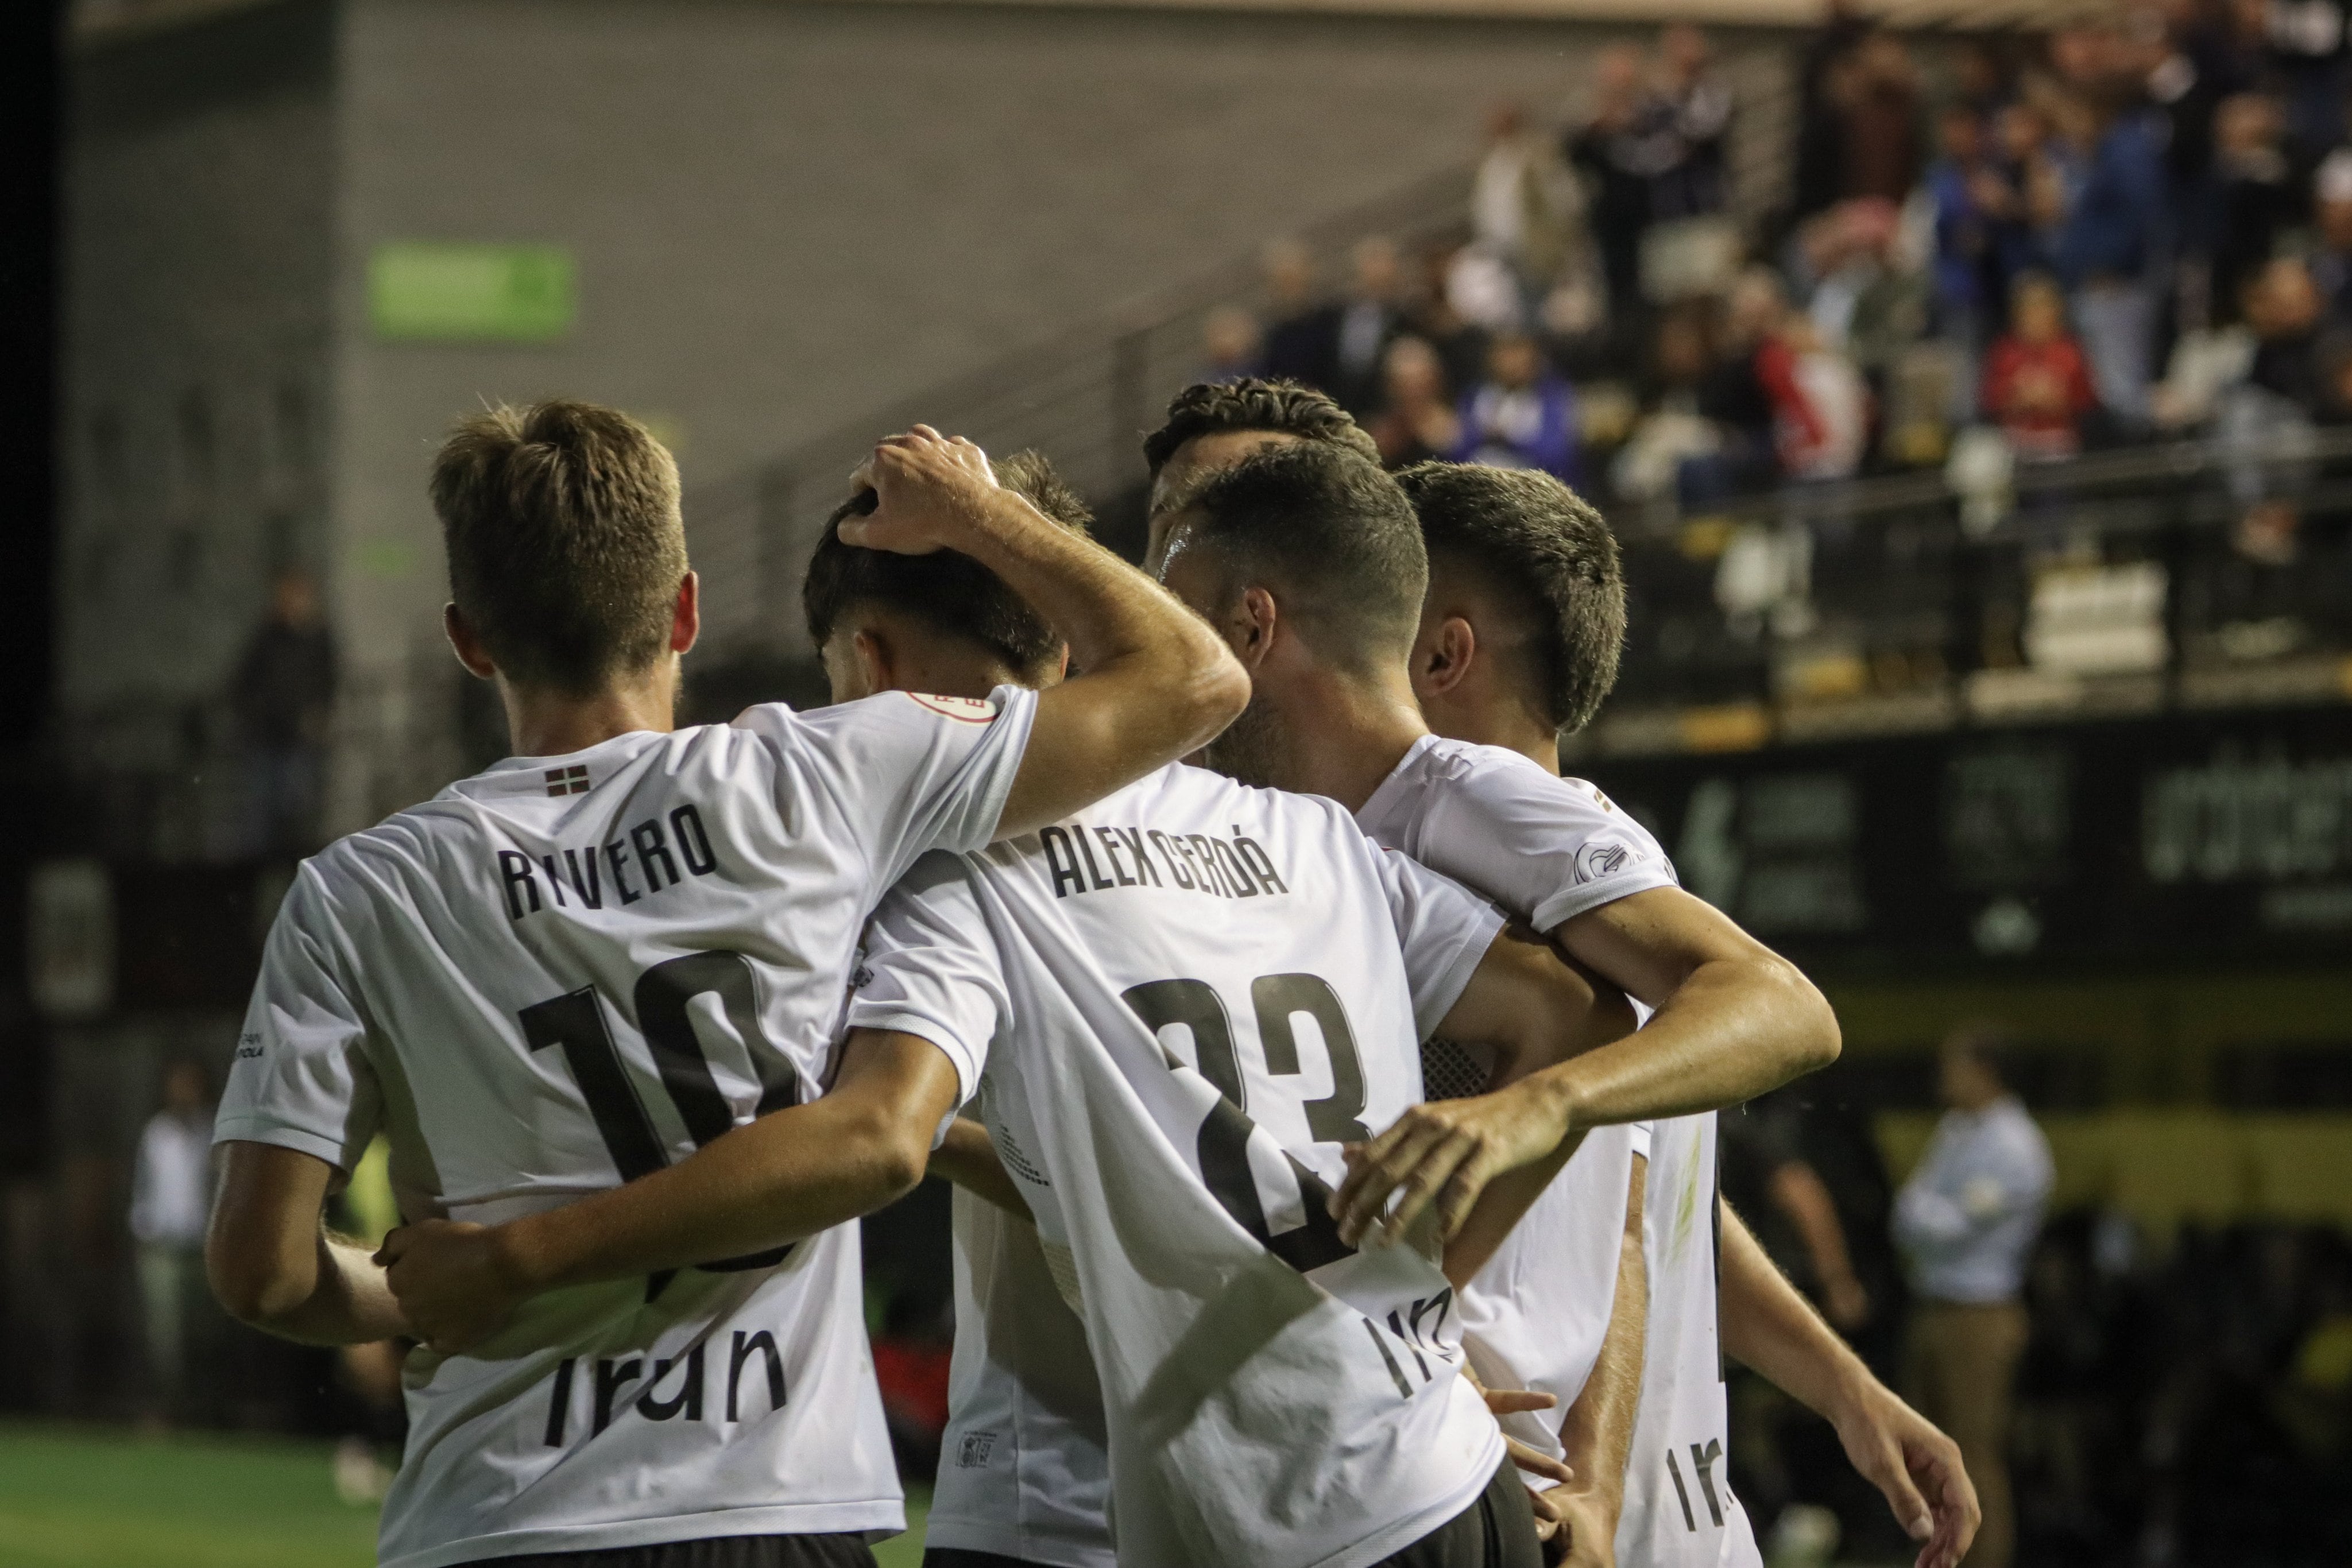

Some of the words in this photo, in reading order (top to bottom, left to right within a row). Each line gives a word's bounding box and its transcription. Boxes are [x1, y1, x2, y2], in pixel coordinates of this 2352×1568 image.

[497, 803, 717, 920] RIVERO
[1039, 824, 1163, 899] ALEX
[1146, 824, 1290, 899] CERDÁ
[517, 950, 802, 1304] 10
[1120, 972, 1390, 1274] 23
